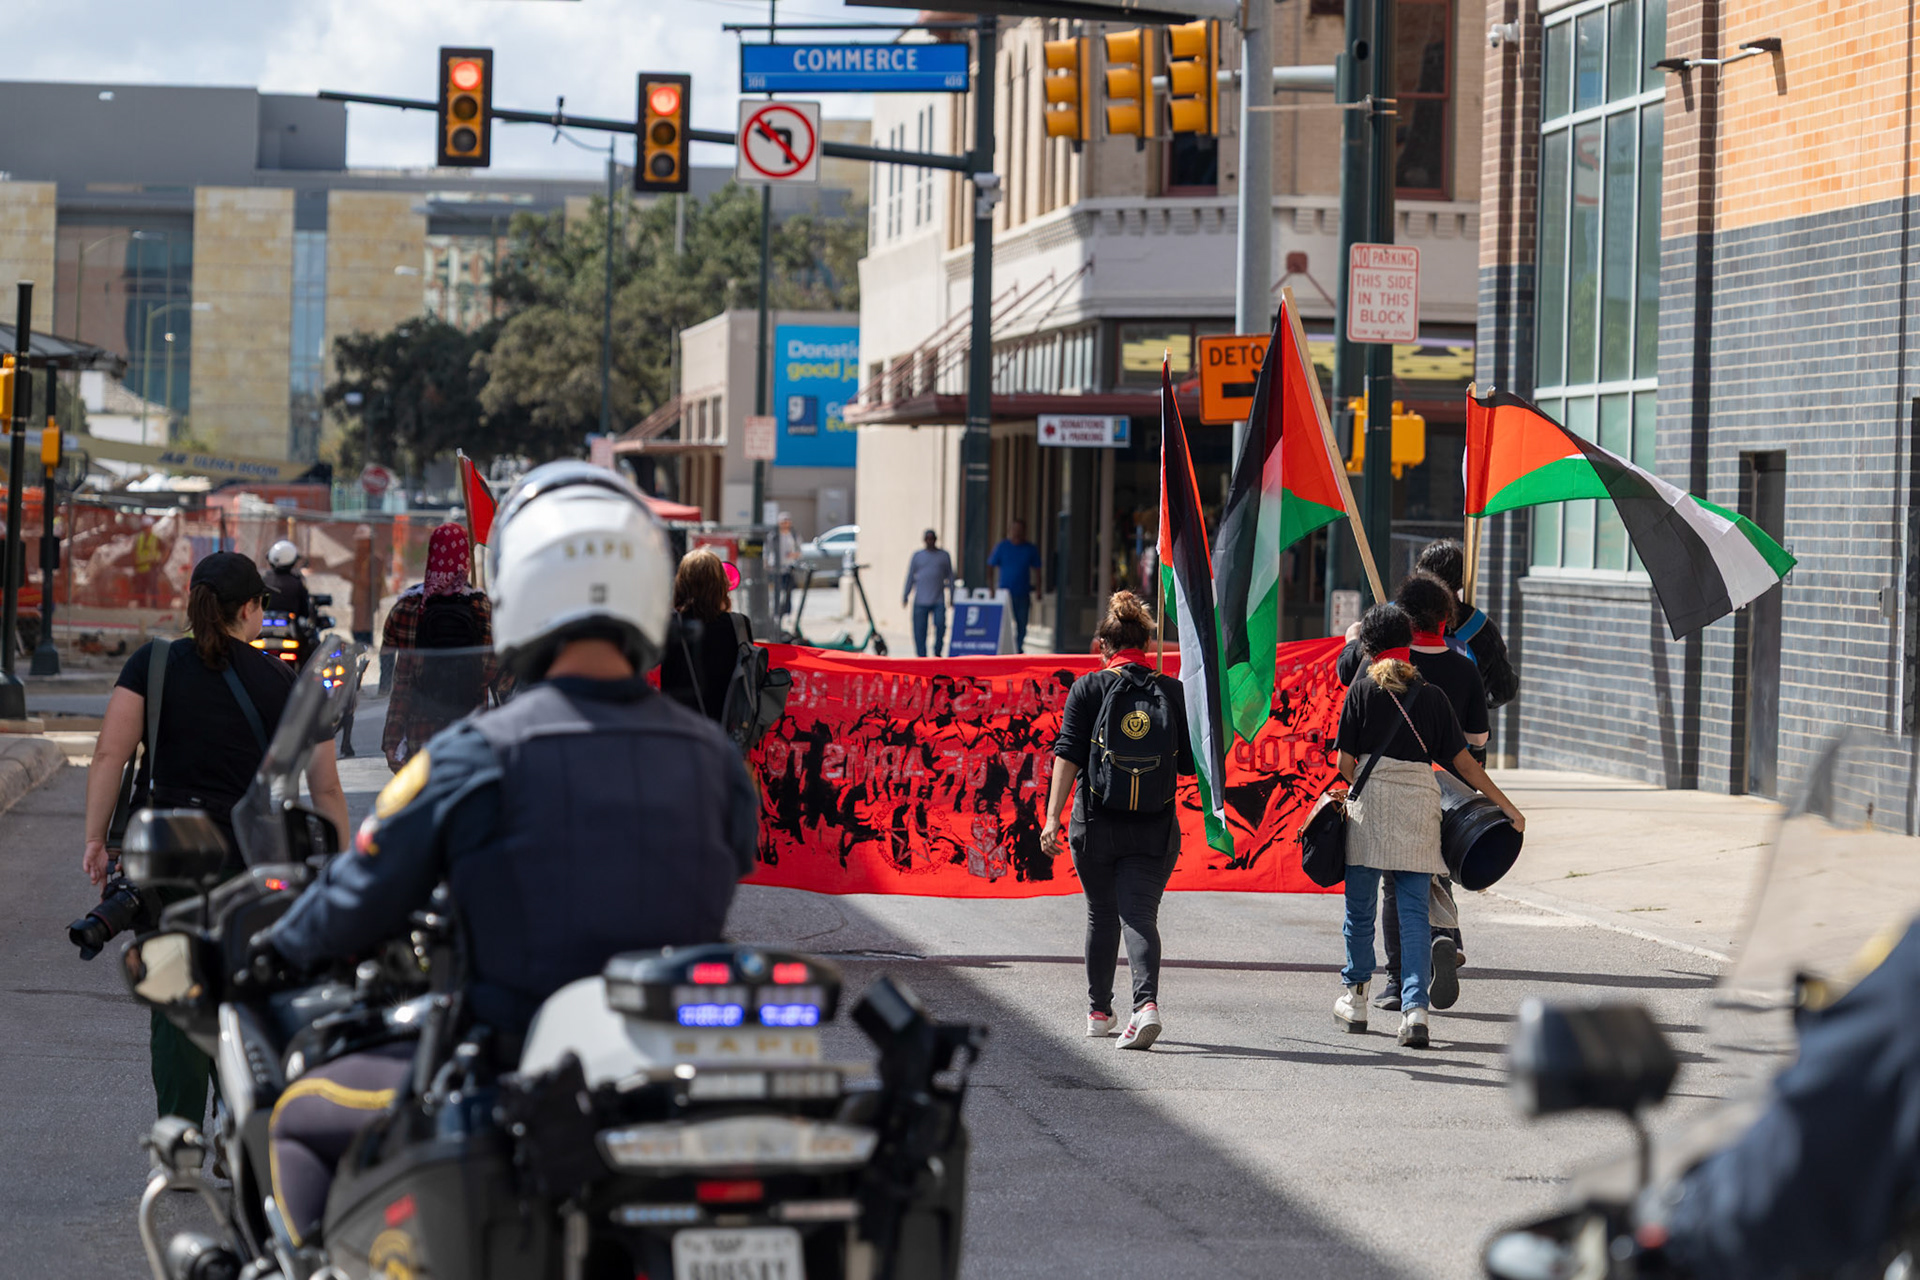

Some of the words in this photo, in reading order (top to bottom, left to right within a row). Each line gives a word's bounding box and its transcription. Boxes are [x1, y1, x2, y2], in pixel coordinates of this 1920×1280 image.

[793, 48, 918, 72] COMMERCE
[1352, 247, 1369, 267] NO
[1373, 251, 1414, 266] PARKING
[1356, 273, 1382, 288] THIS
[1387, 275, 1414, 290] SIDE
[1358, 291, 1372, 305] IN
[1380, 292, 1409, 307] THIS
[1360, 309, 1406, 325] BLOCK
[1209, 344, 1264, 367] DETO
[787, 362, 841, 382] good
[842, 358, 859, 383] jo
[1060, 420, 1105, 429] DONATIONS
[1070, 433, 1104, 441] PARKING
